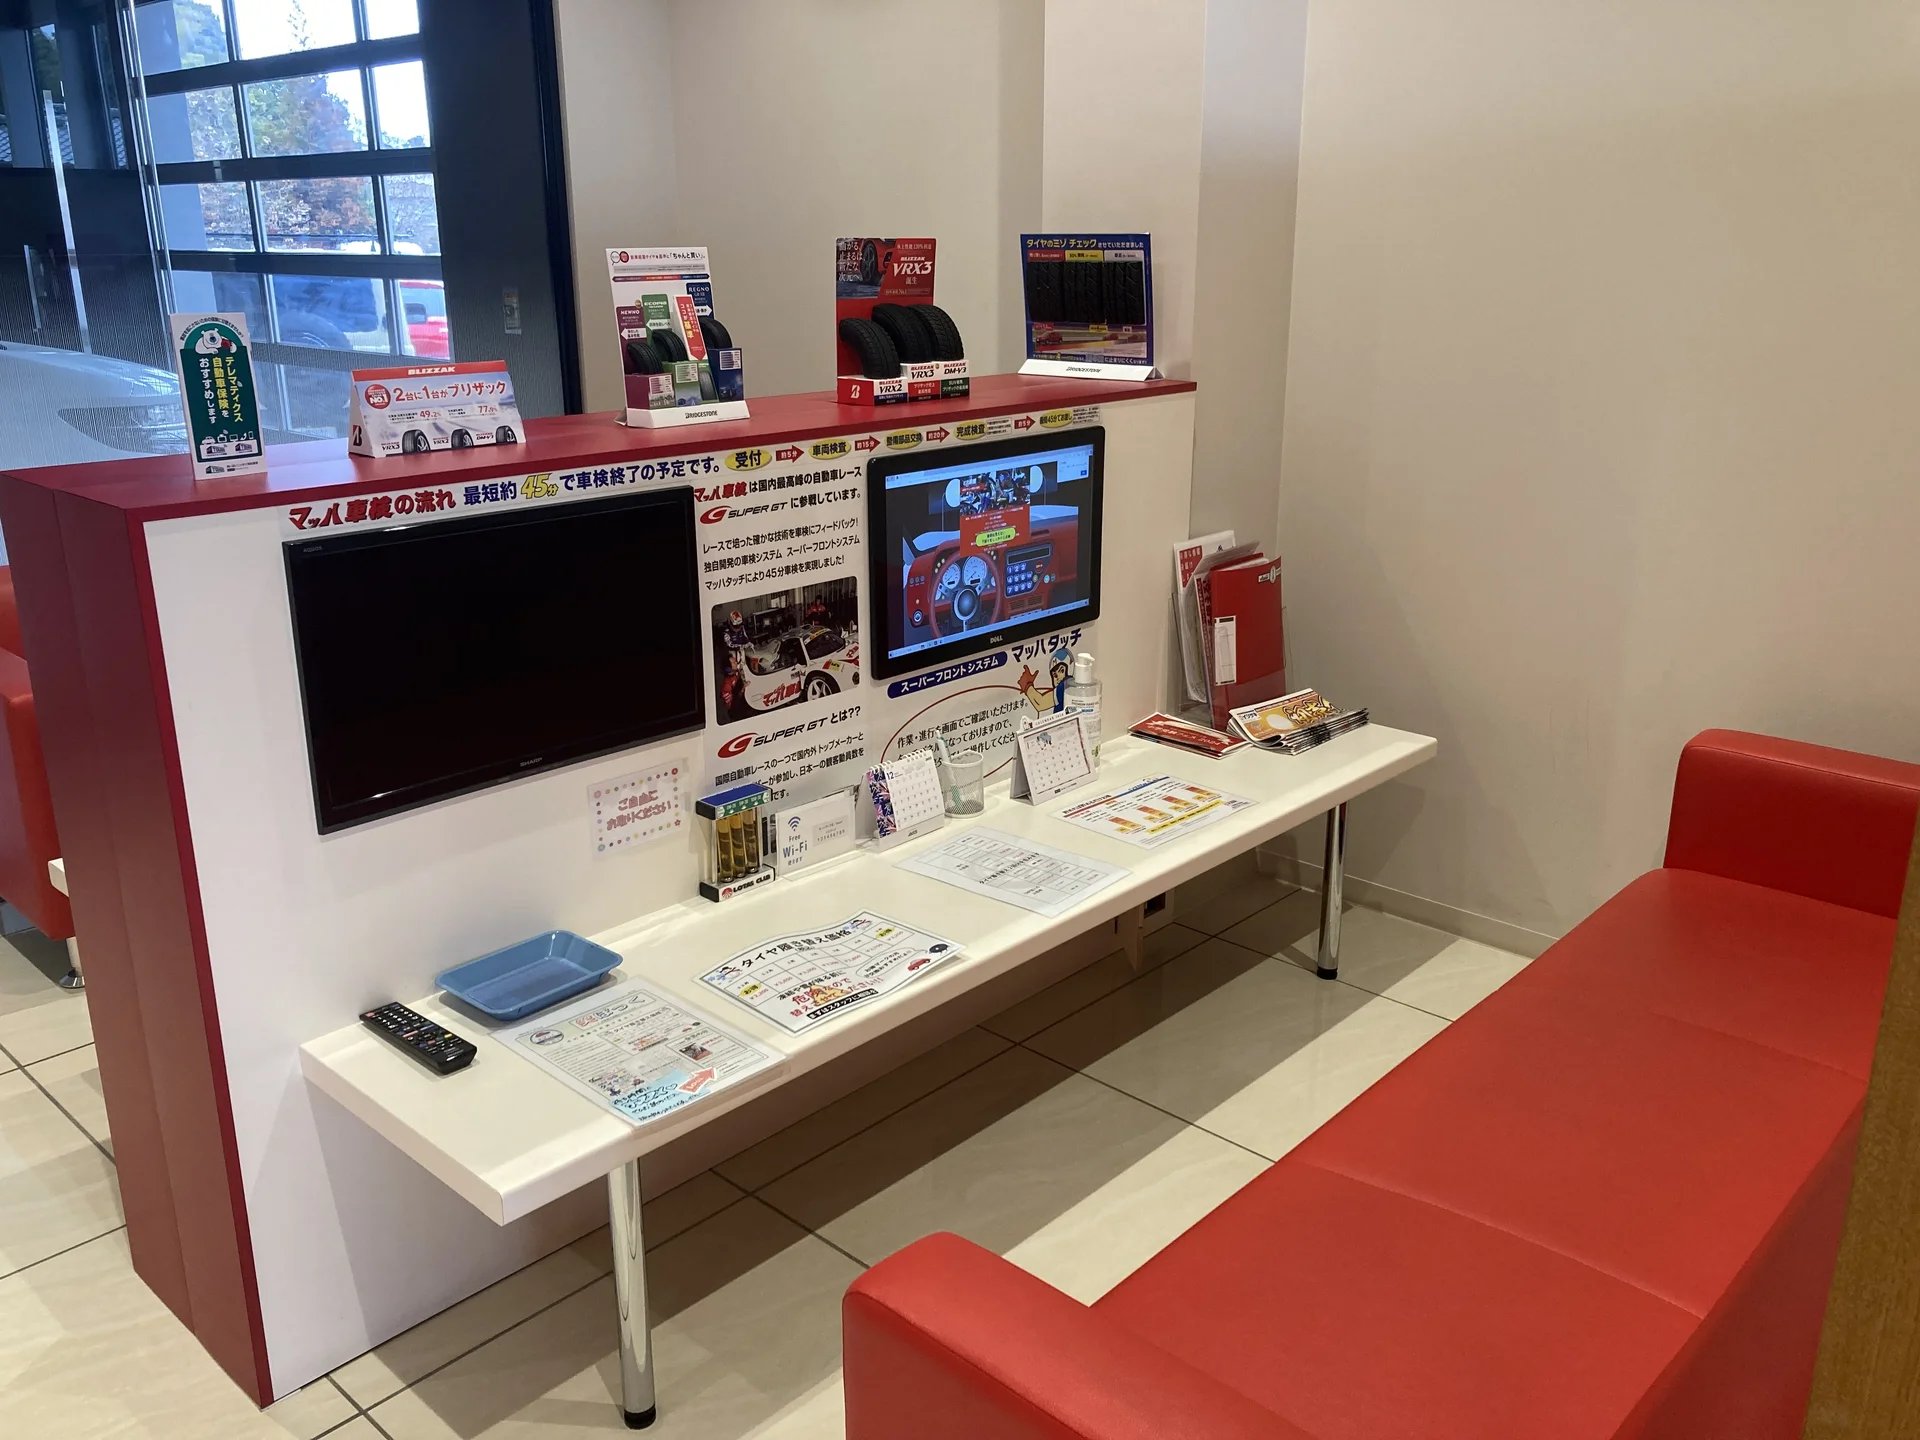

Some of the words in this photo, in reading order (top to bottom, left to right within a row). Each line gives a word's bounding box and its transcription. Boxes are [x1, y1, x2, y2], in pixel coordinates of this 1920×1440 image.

[1069, 239, 1097, 248] チェック
[893, 261, 933, 277] VRX3
[407, 366, 456, 375] BLIZZAK
[911, 369, 935, 379] VRX3
[199, 358, 216, 424] おすすめします
[212, 357, 229, 417] 自動車保険を
[225, 356, 243, 422] テレマティクス
[393, 381, 507, 402] 2台に1台がブリザック
[879, 384, 903, 394] VRX2
[685, 410, 718, 419] BRIDGESTONE
[928, 432, 945, 441] 約20分
[956, 423, 986, 437] 完成検査
[856, 439, 875, 450] 約15分
[886, 431, 923, 447] 整備部品交換
[812, 442, 847, 456] 車両検査
[735, 451, 762, 469] 受付
[771, 501, 788, 512] GT
[790, 487, 861, 509] に参戦しています。
[288, 489, 457, 531] マッハ車検の流れ
[704, 548, 783, 574] 独自開発の車検システム
[786, 534, 860, 558] スーパーフロントシステム
[990, 636, 1003, 644] DELL
[1011, 627, 1083, 663] マッハタッチ
[901, 656, 1000, 693] スーパーフロントシステム
[807, 716, 829, 731] GT
[782, 840, 808, 858] Wi-Fi
[742, 929, 852, 968] タイヤ履き替え価格
